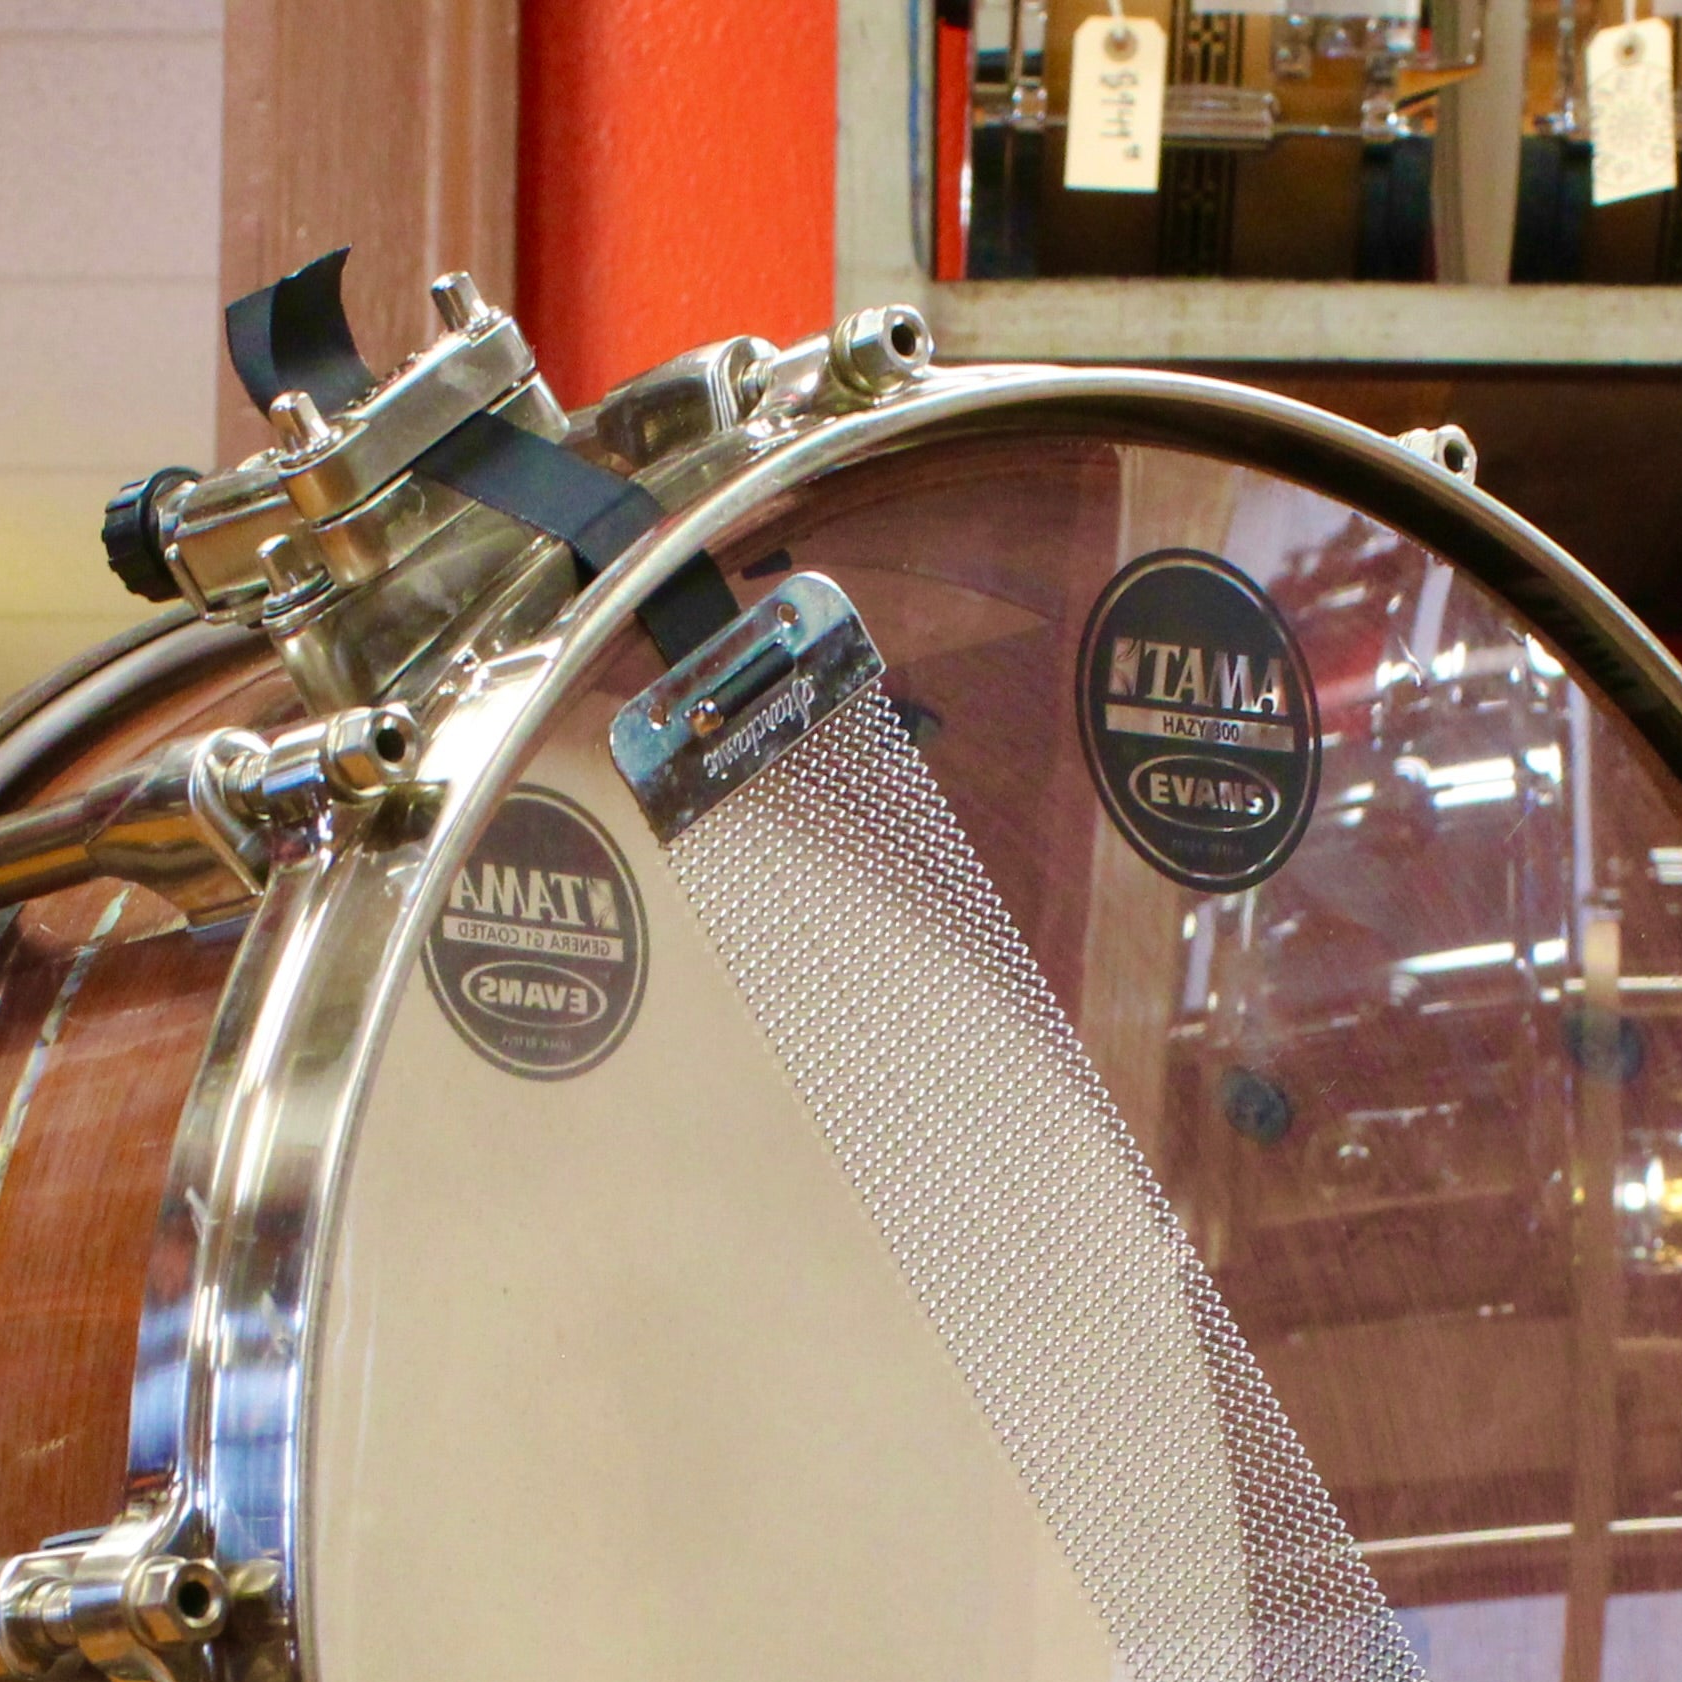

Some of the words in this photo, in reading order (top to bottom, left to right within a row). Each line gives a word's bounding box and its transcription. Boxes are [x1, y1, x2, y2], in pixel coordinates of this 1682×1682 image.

[1145, 640, 1289, 717] TAMA
[703, 673, 816, 780] Starclassic
[1162, 715, 1206, 735] HAZY
[1215, 722, 1240, 742] 300
[1149, 772, 1264, 816] EVANS
